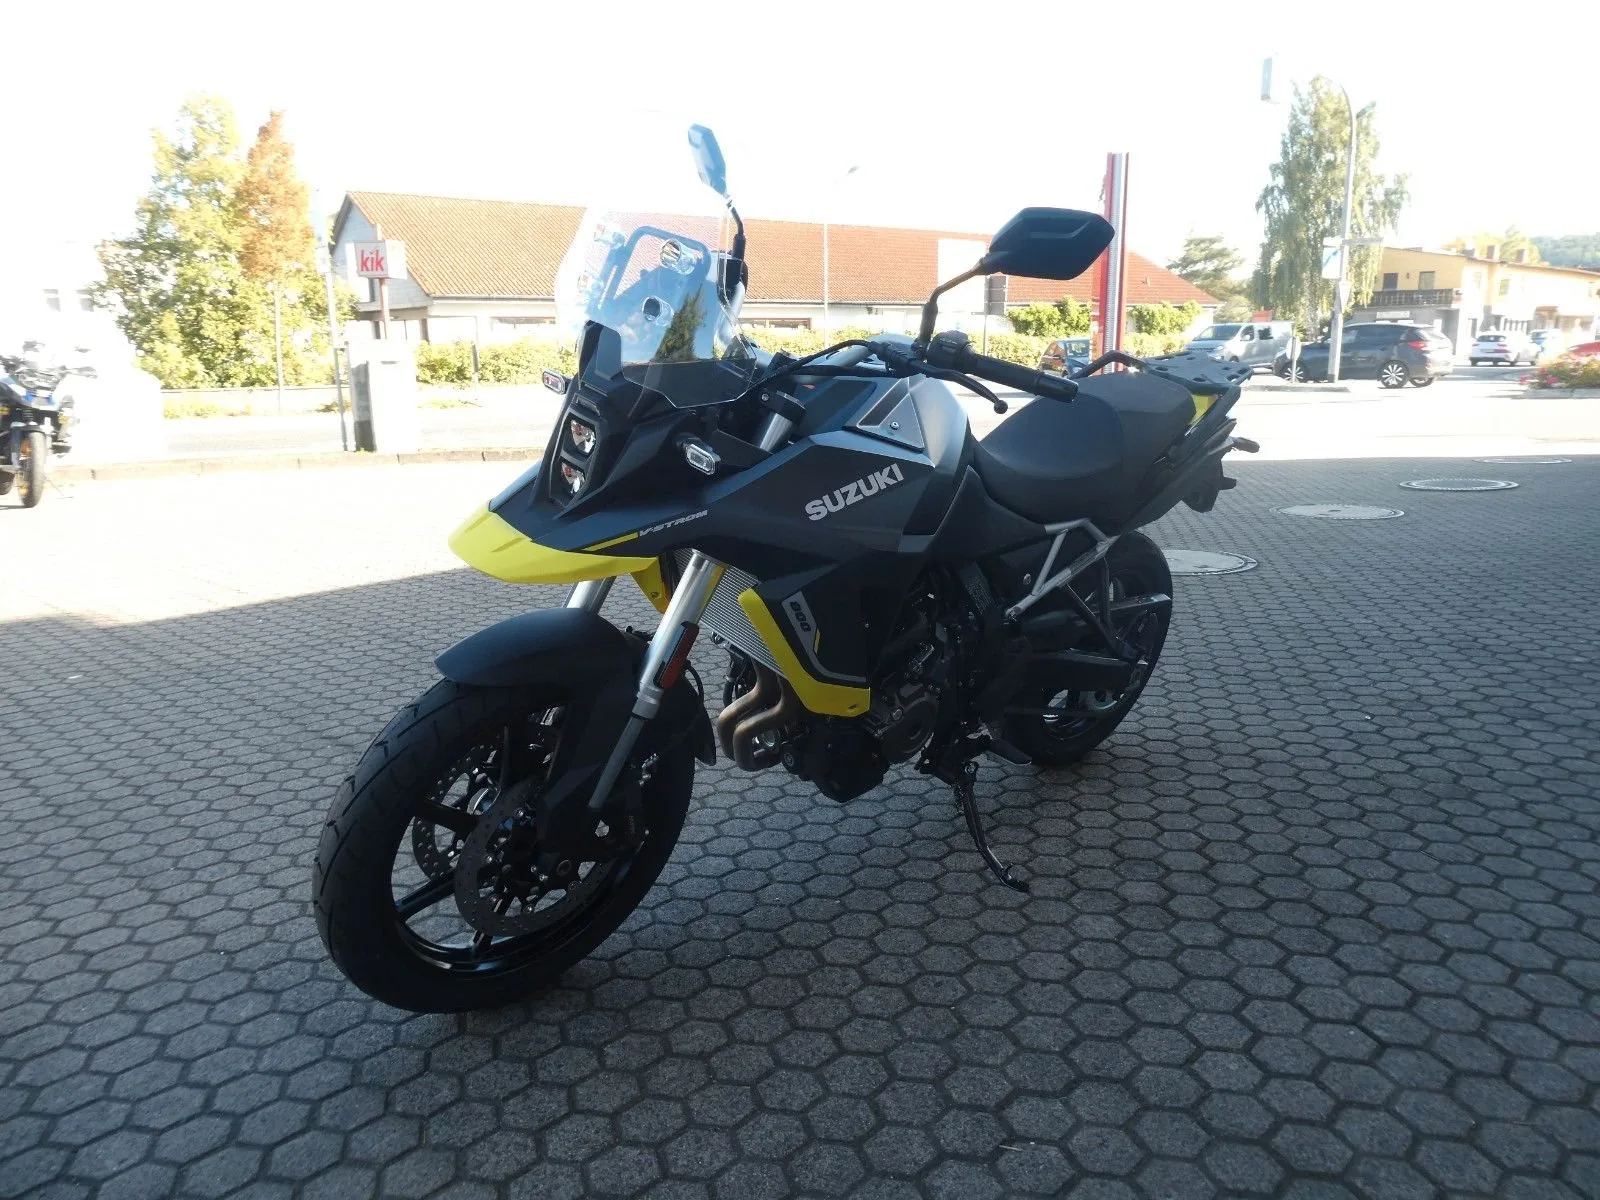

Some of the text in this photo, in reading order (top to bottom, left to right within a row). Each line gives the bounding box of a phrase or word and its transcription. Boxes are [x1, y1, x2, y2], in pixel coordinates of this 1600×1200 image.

[360, 249, 385, 272] kik
[804, 463, 904, 521] SUZUKI
[639, 509, 708, 537] V-STROM
[789, 601, 812, 632] 800
